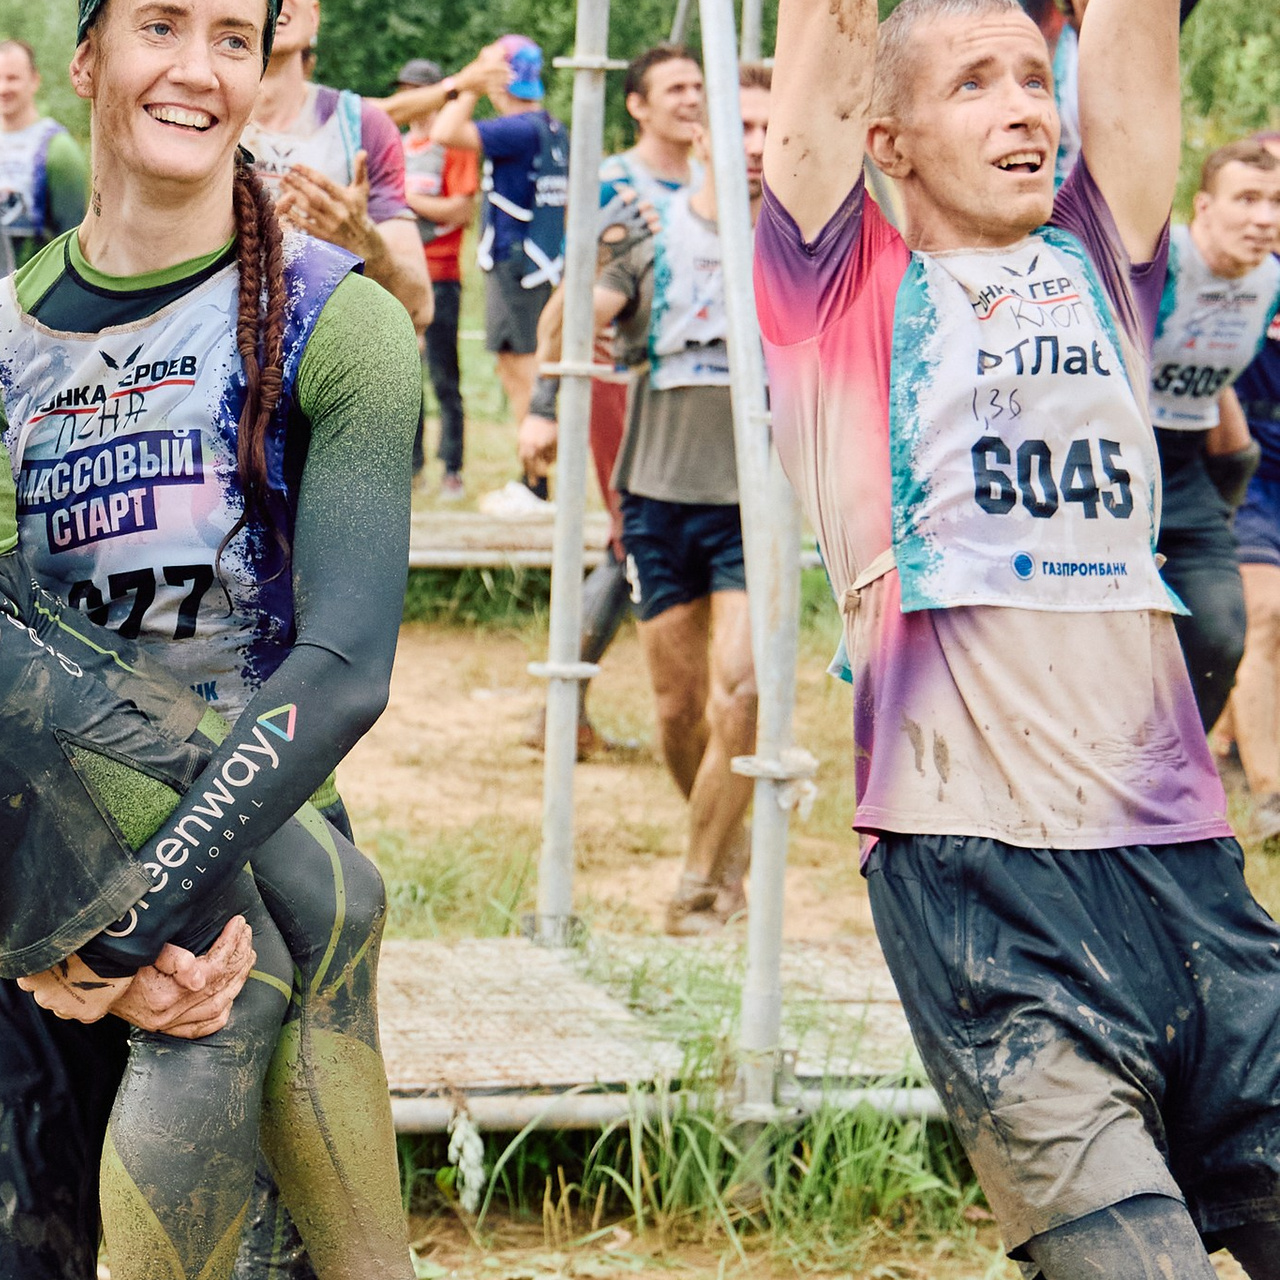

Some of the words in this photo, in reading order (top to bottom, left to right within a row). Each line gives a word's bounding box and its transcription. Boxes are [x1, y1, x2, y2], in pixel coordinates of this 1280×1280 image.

[21, 428, 195, 506] МАССОВЫЙ
[970, 435, 1134, 519] 6045
[51, 487, 147, 547] СТАРТ
[1042, 560, 1128, 578] ГАЗПРОМБАНК
[181, 799, 264, 890] GLOBAL
